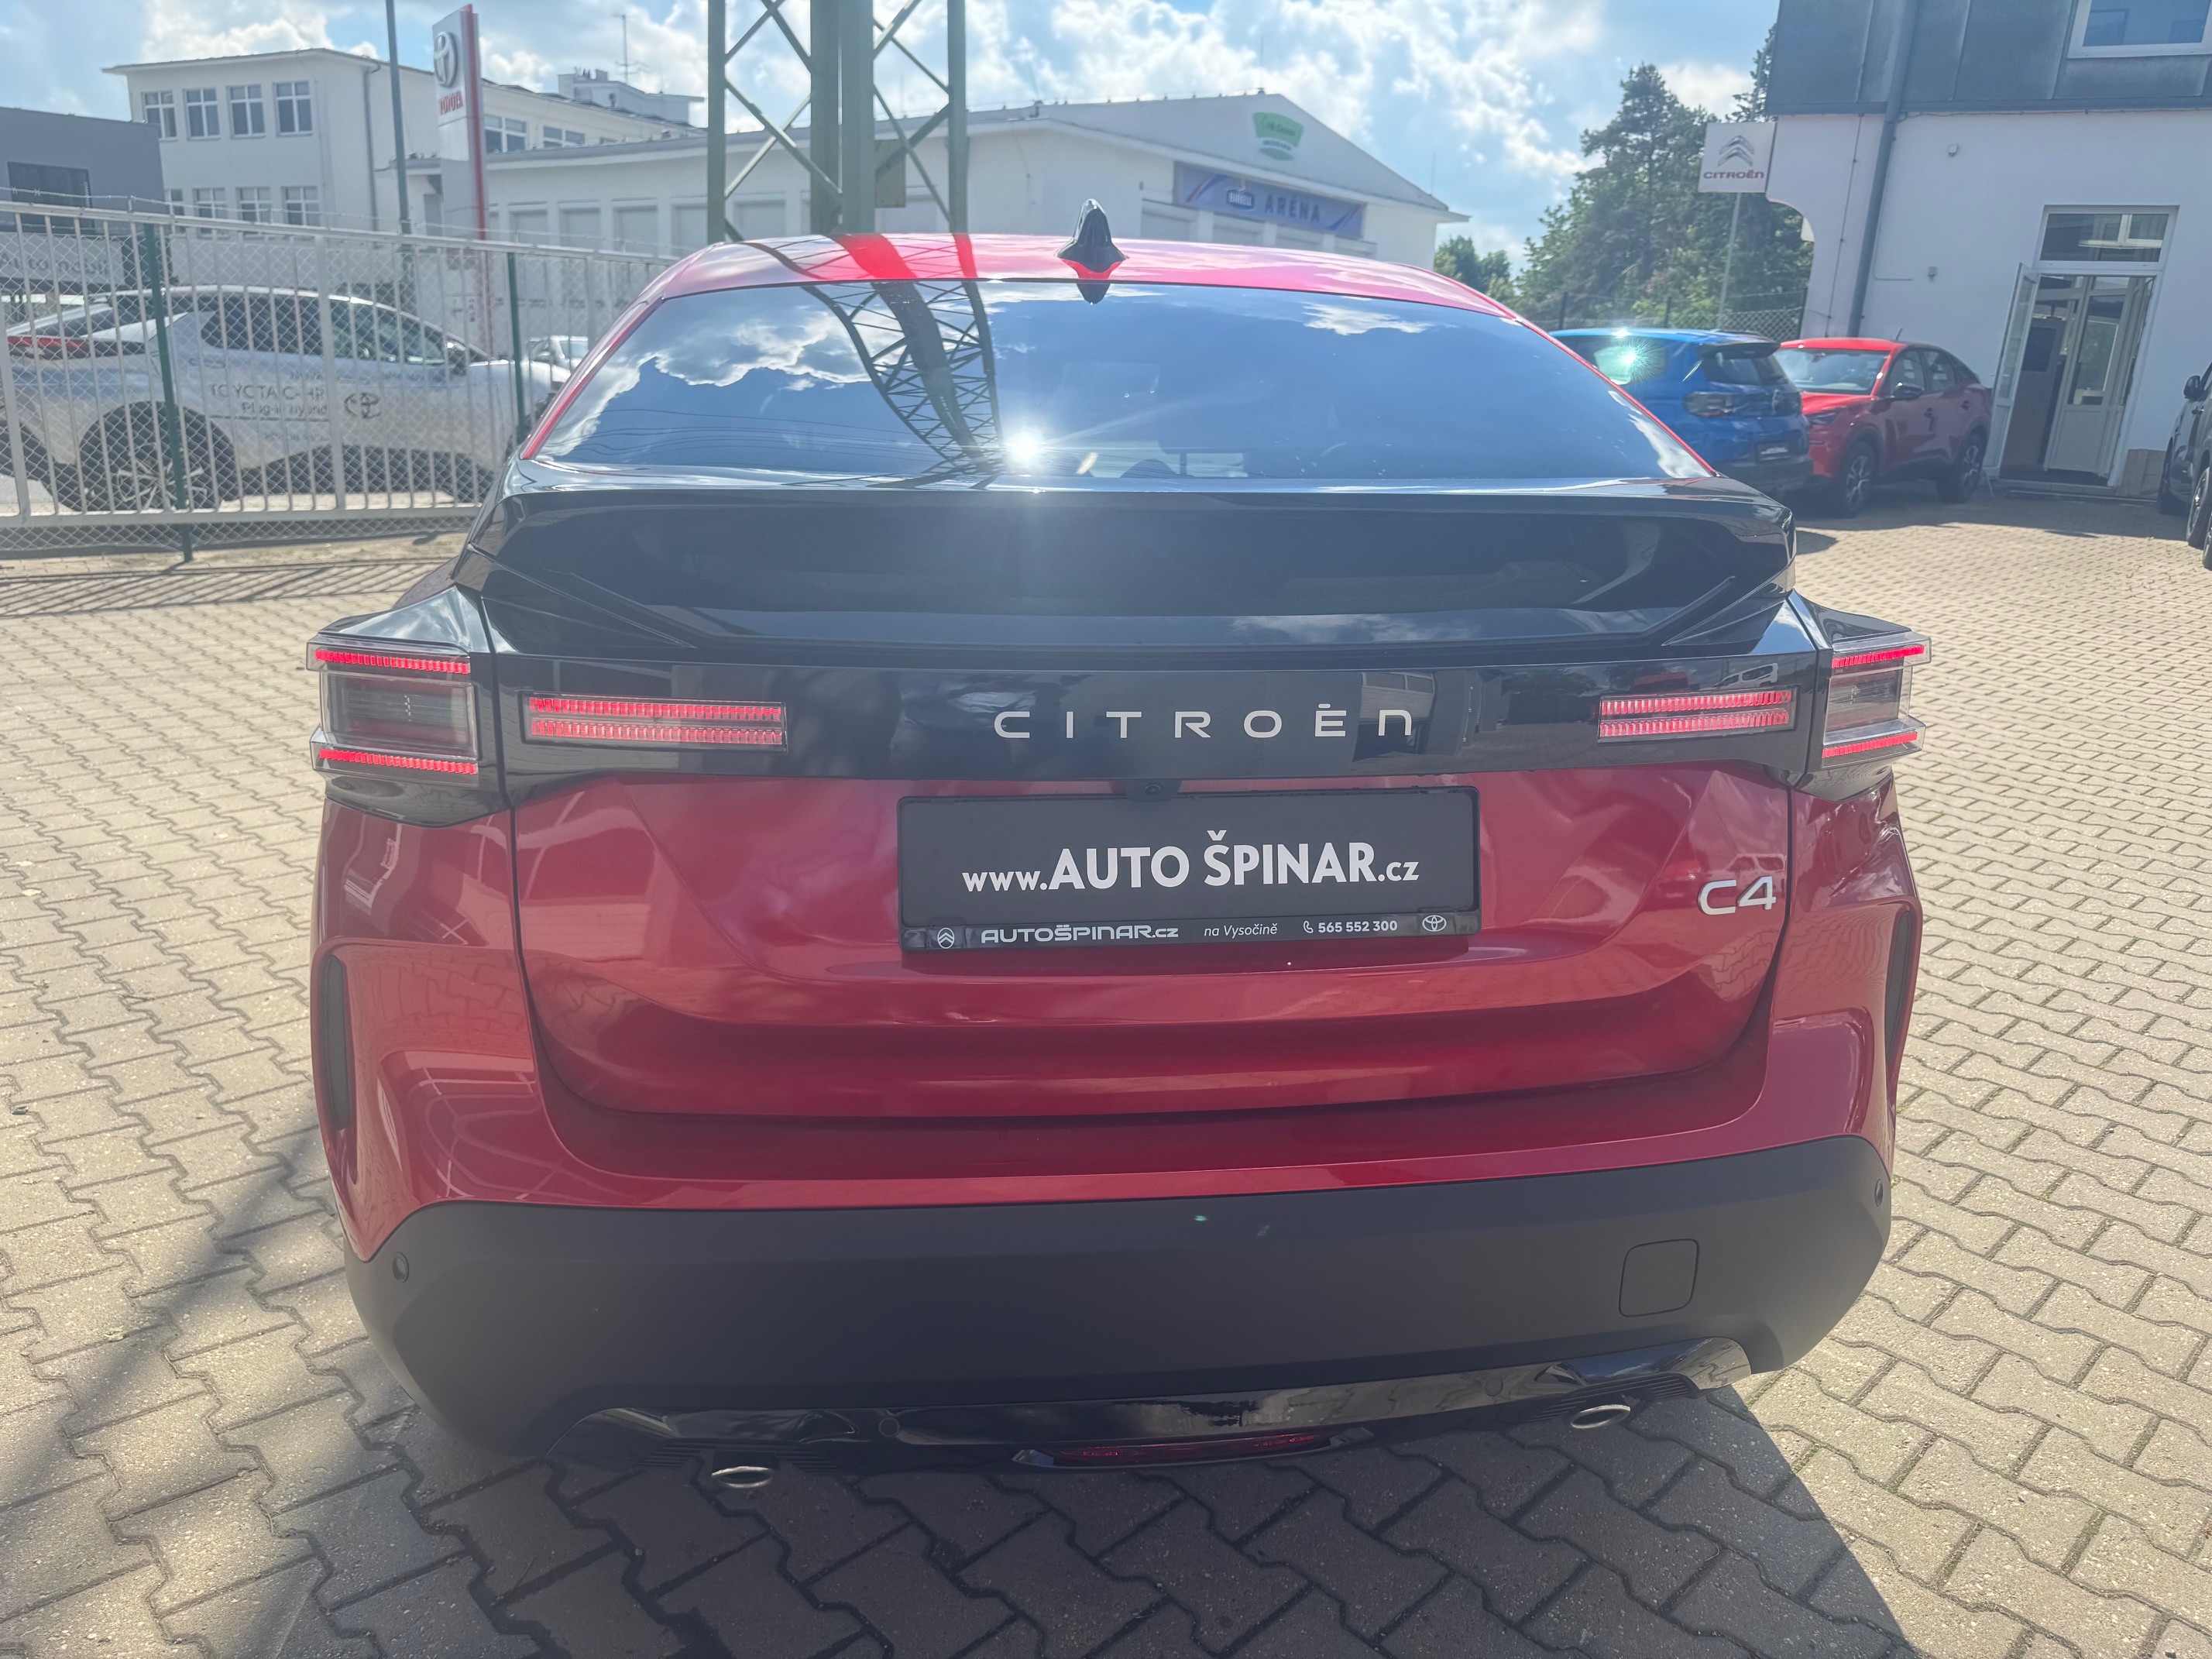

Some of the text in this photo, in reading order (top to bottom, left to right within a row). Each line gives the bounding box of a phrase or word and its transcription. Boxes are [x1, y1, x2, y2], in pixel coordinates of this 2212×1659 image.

[439, 91, 463, 115] TOYOTA
[962, 830, 1420, 891] www.AUTO ŠPINAR.cz
[1698, 875, 1777, 915] C4
[1204, 927, 1220, 937] na
[1224, 922, 1278, 939] Vysočině
[1317, 922, 1342, 933] 565
[1345, 920, 1370, 932] 552
[1372, 920, 1398, 932] 300
